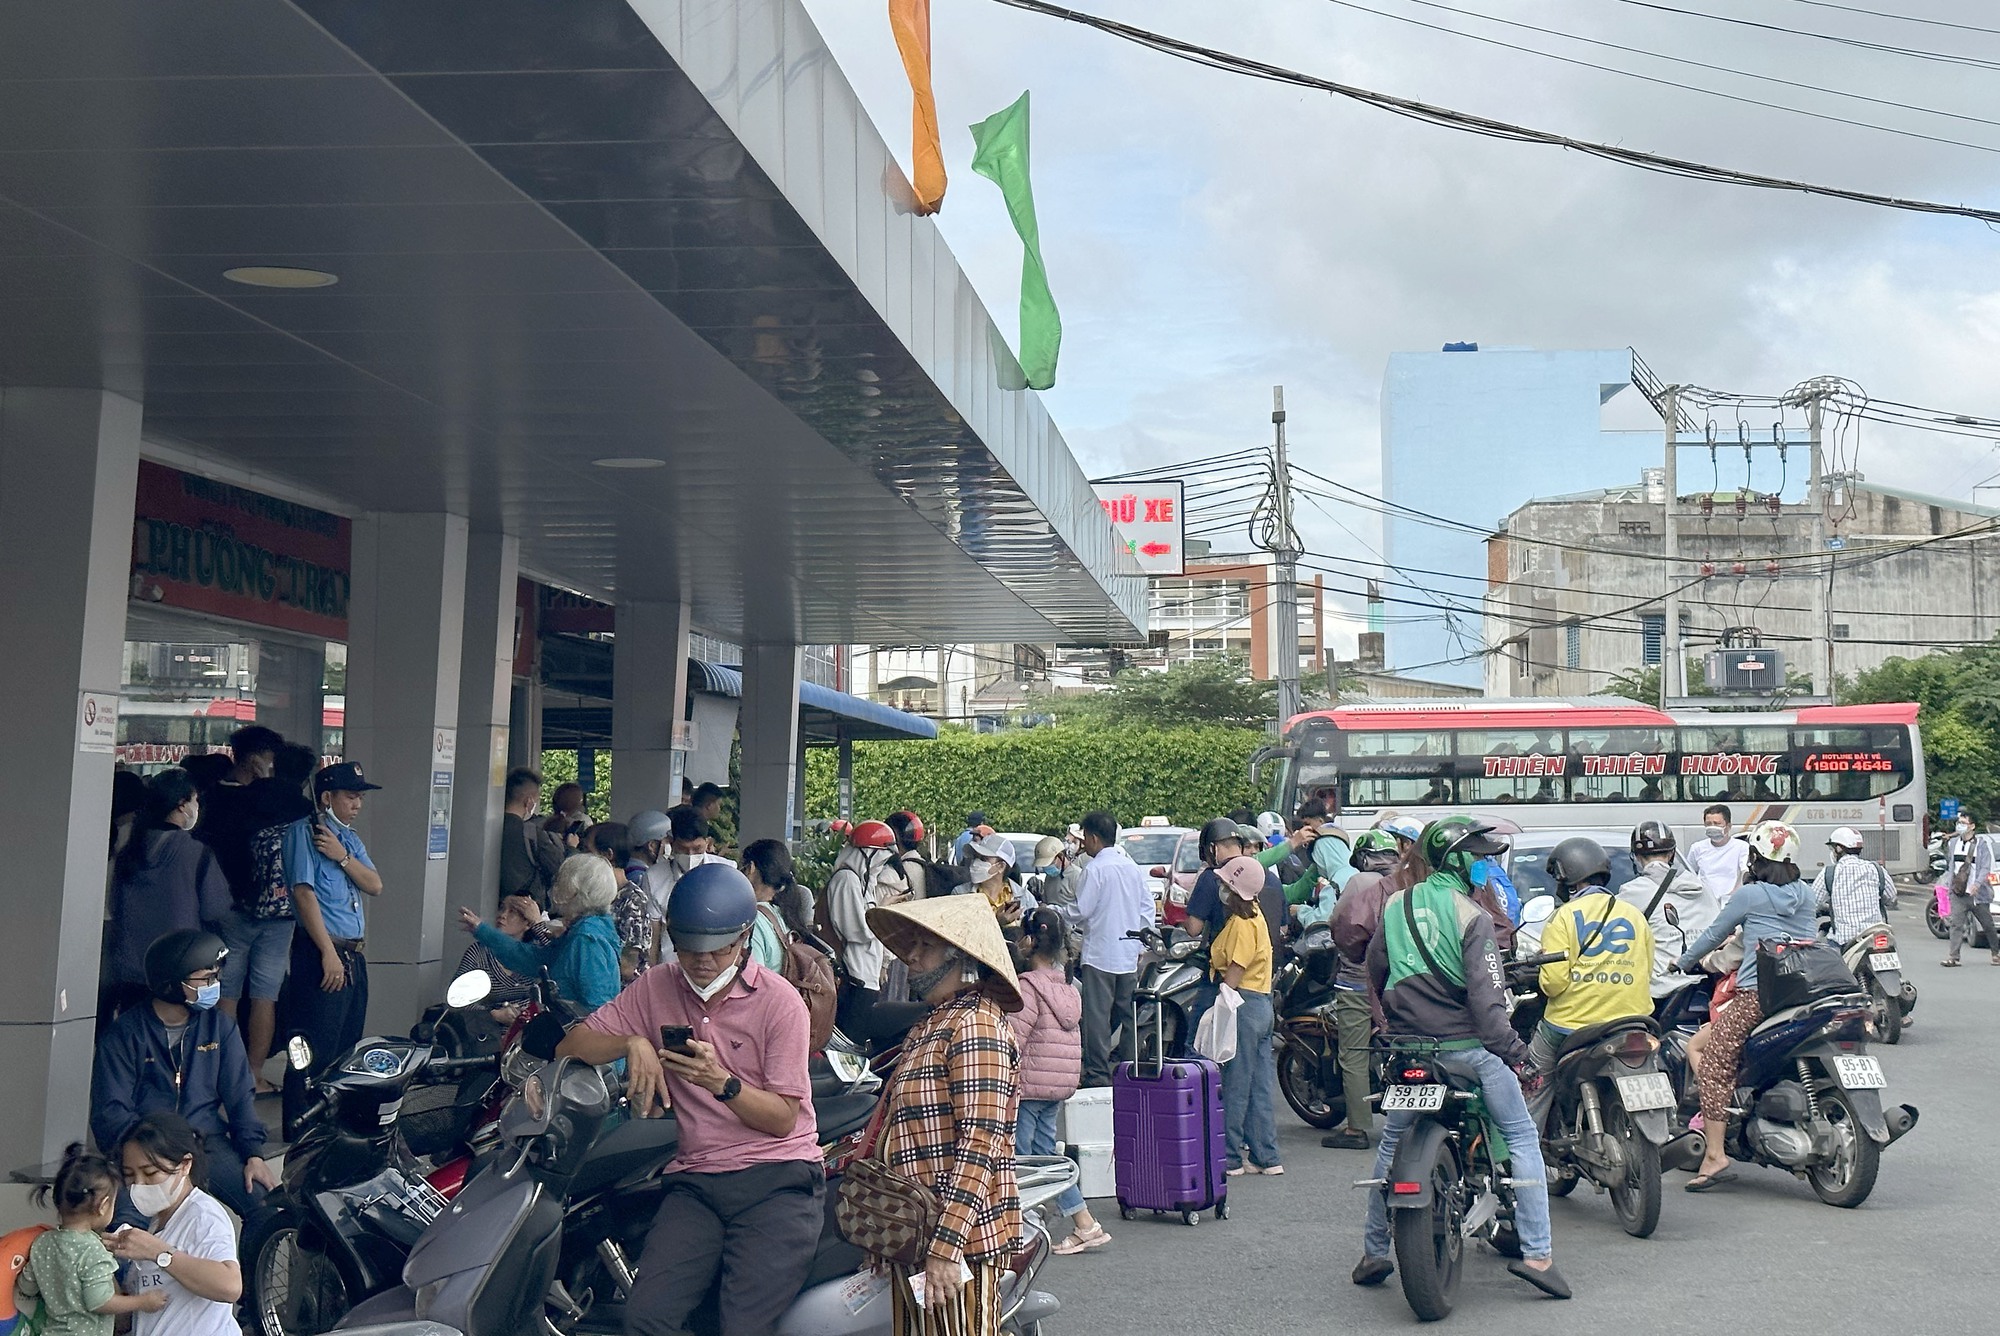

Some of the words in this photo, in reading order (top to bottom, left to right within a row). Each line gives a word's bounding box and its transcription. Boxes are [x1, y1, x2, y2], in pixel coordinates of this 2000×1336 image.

[1143, 499, 1174, 523] XE
[1483, 753, 1566, 776] THIÊN
[1583, 752, 1666, 775] THIÊN
[1680, 752, 1782, 775] HƯƠNG
[1814, 761, 1849, 771] 1900
[1852, 761, 1892, 771] 4646
[1572, 909, 1636, 957] be
[1484, 952, 1502, 989] gojek
